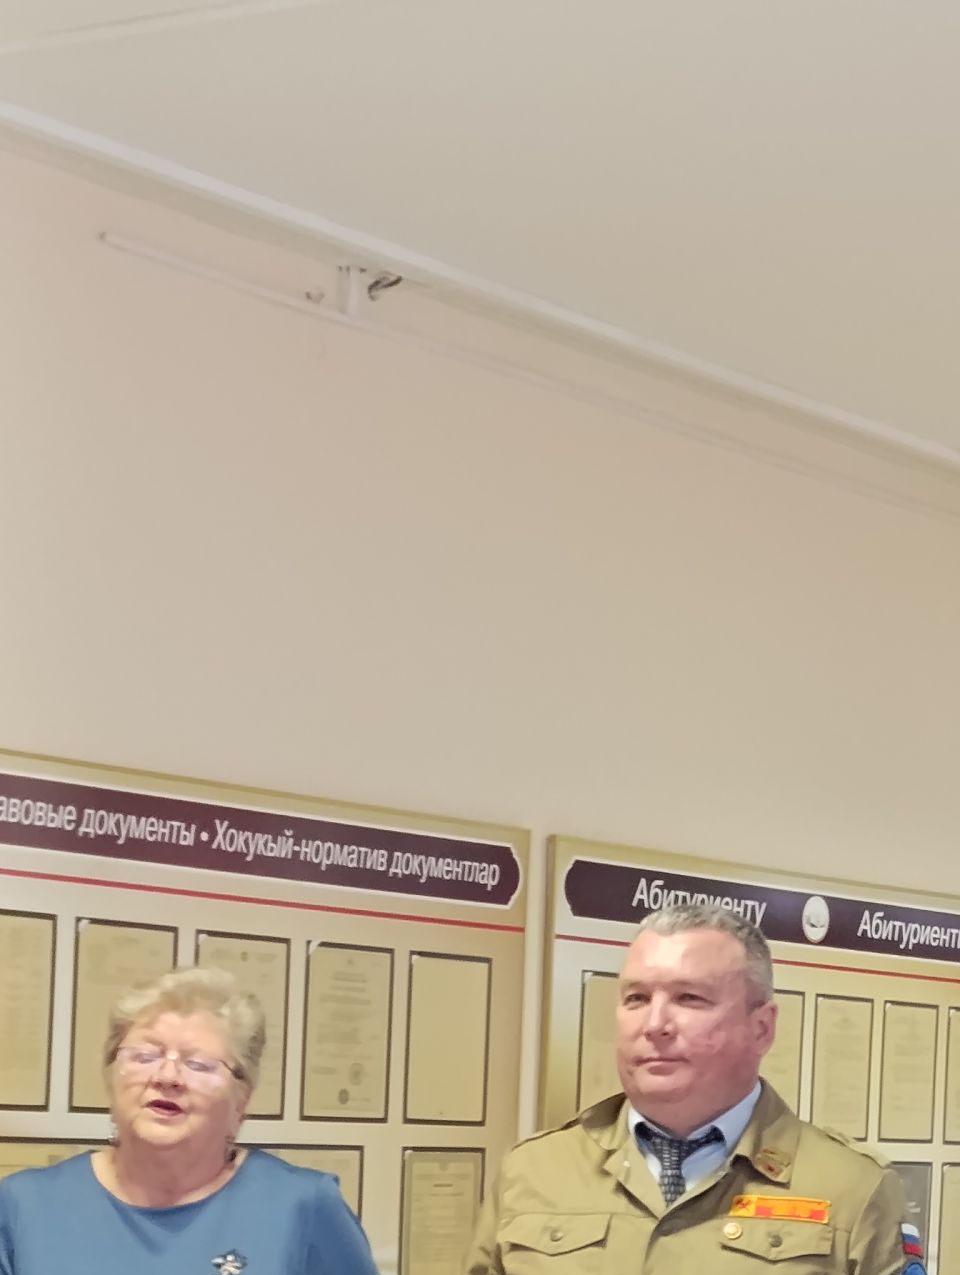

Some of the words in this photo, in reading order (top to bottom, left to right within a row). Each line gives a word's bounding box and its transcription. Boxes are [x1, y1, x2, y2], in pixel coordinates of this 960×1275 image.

[78, 808, 197, 847] документы
[211, 818, 388, 871] Хокукый-норматив
[388, 851, 500, 891] документлар
